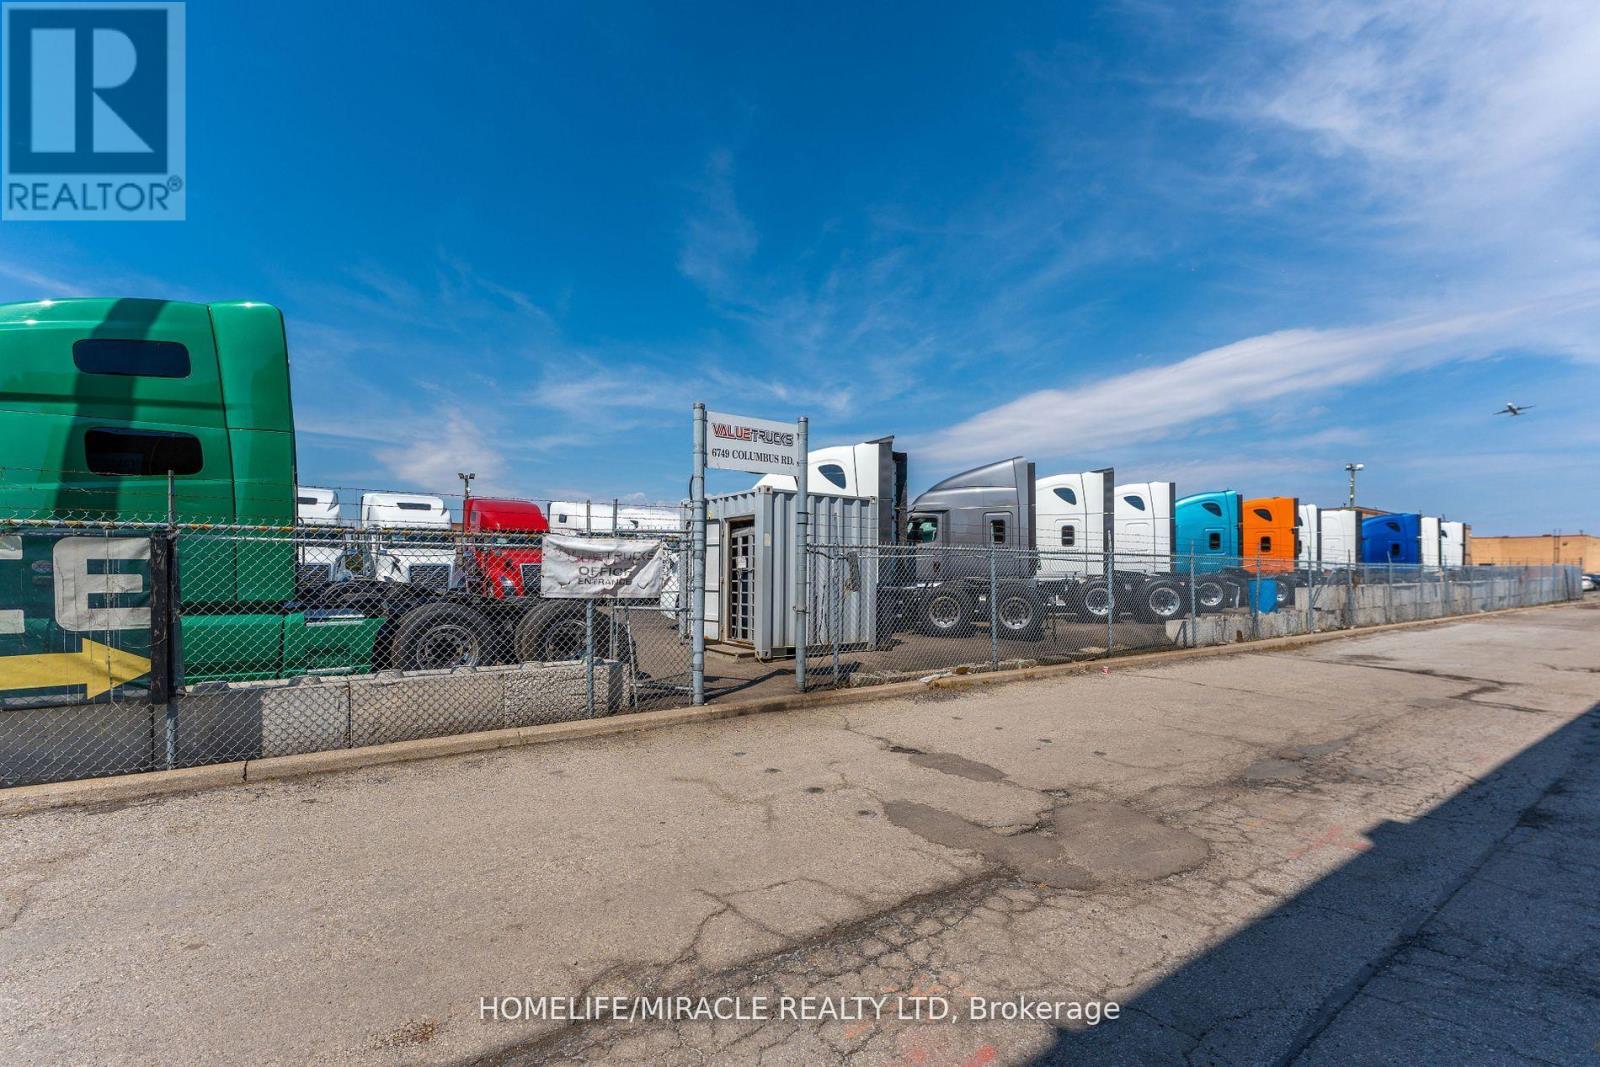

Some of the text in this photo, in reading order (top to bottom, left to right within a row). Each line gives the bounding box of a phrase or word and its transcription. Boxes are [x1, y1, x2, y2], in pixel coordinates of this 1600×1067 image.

[711, 447, 795, 466] 6749 COLUMBUS RD.
[577, 577, 633, 586] ENTRANCE
